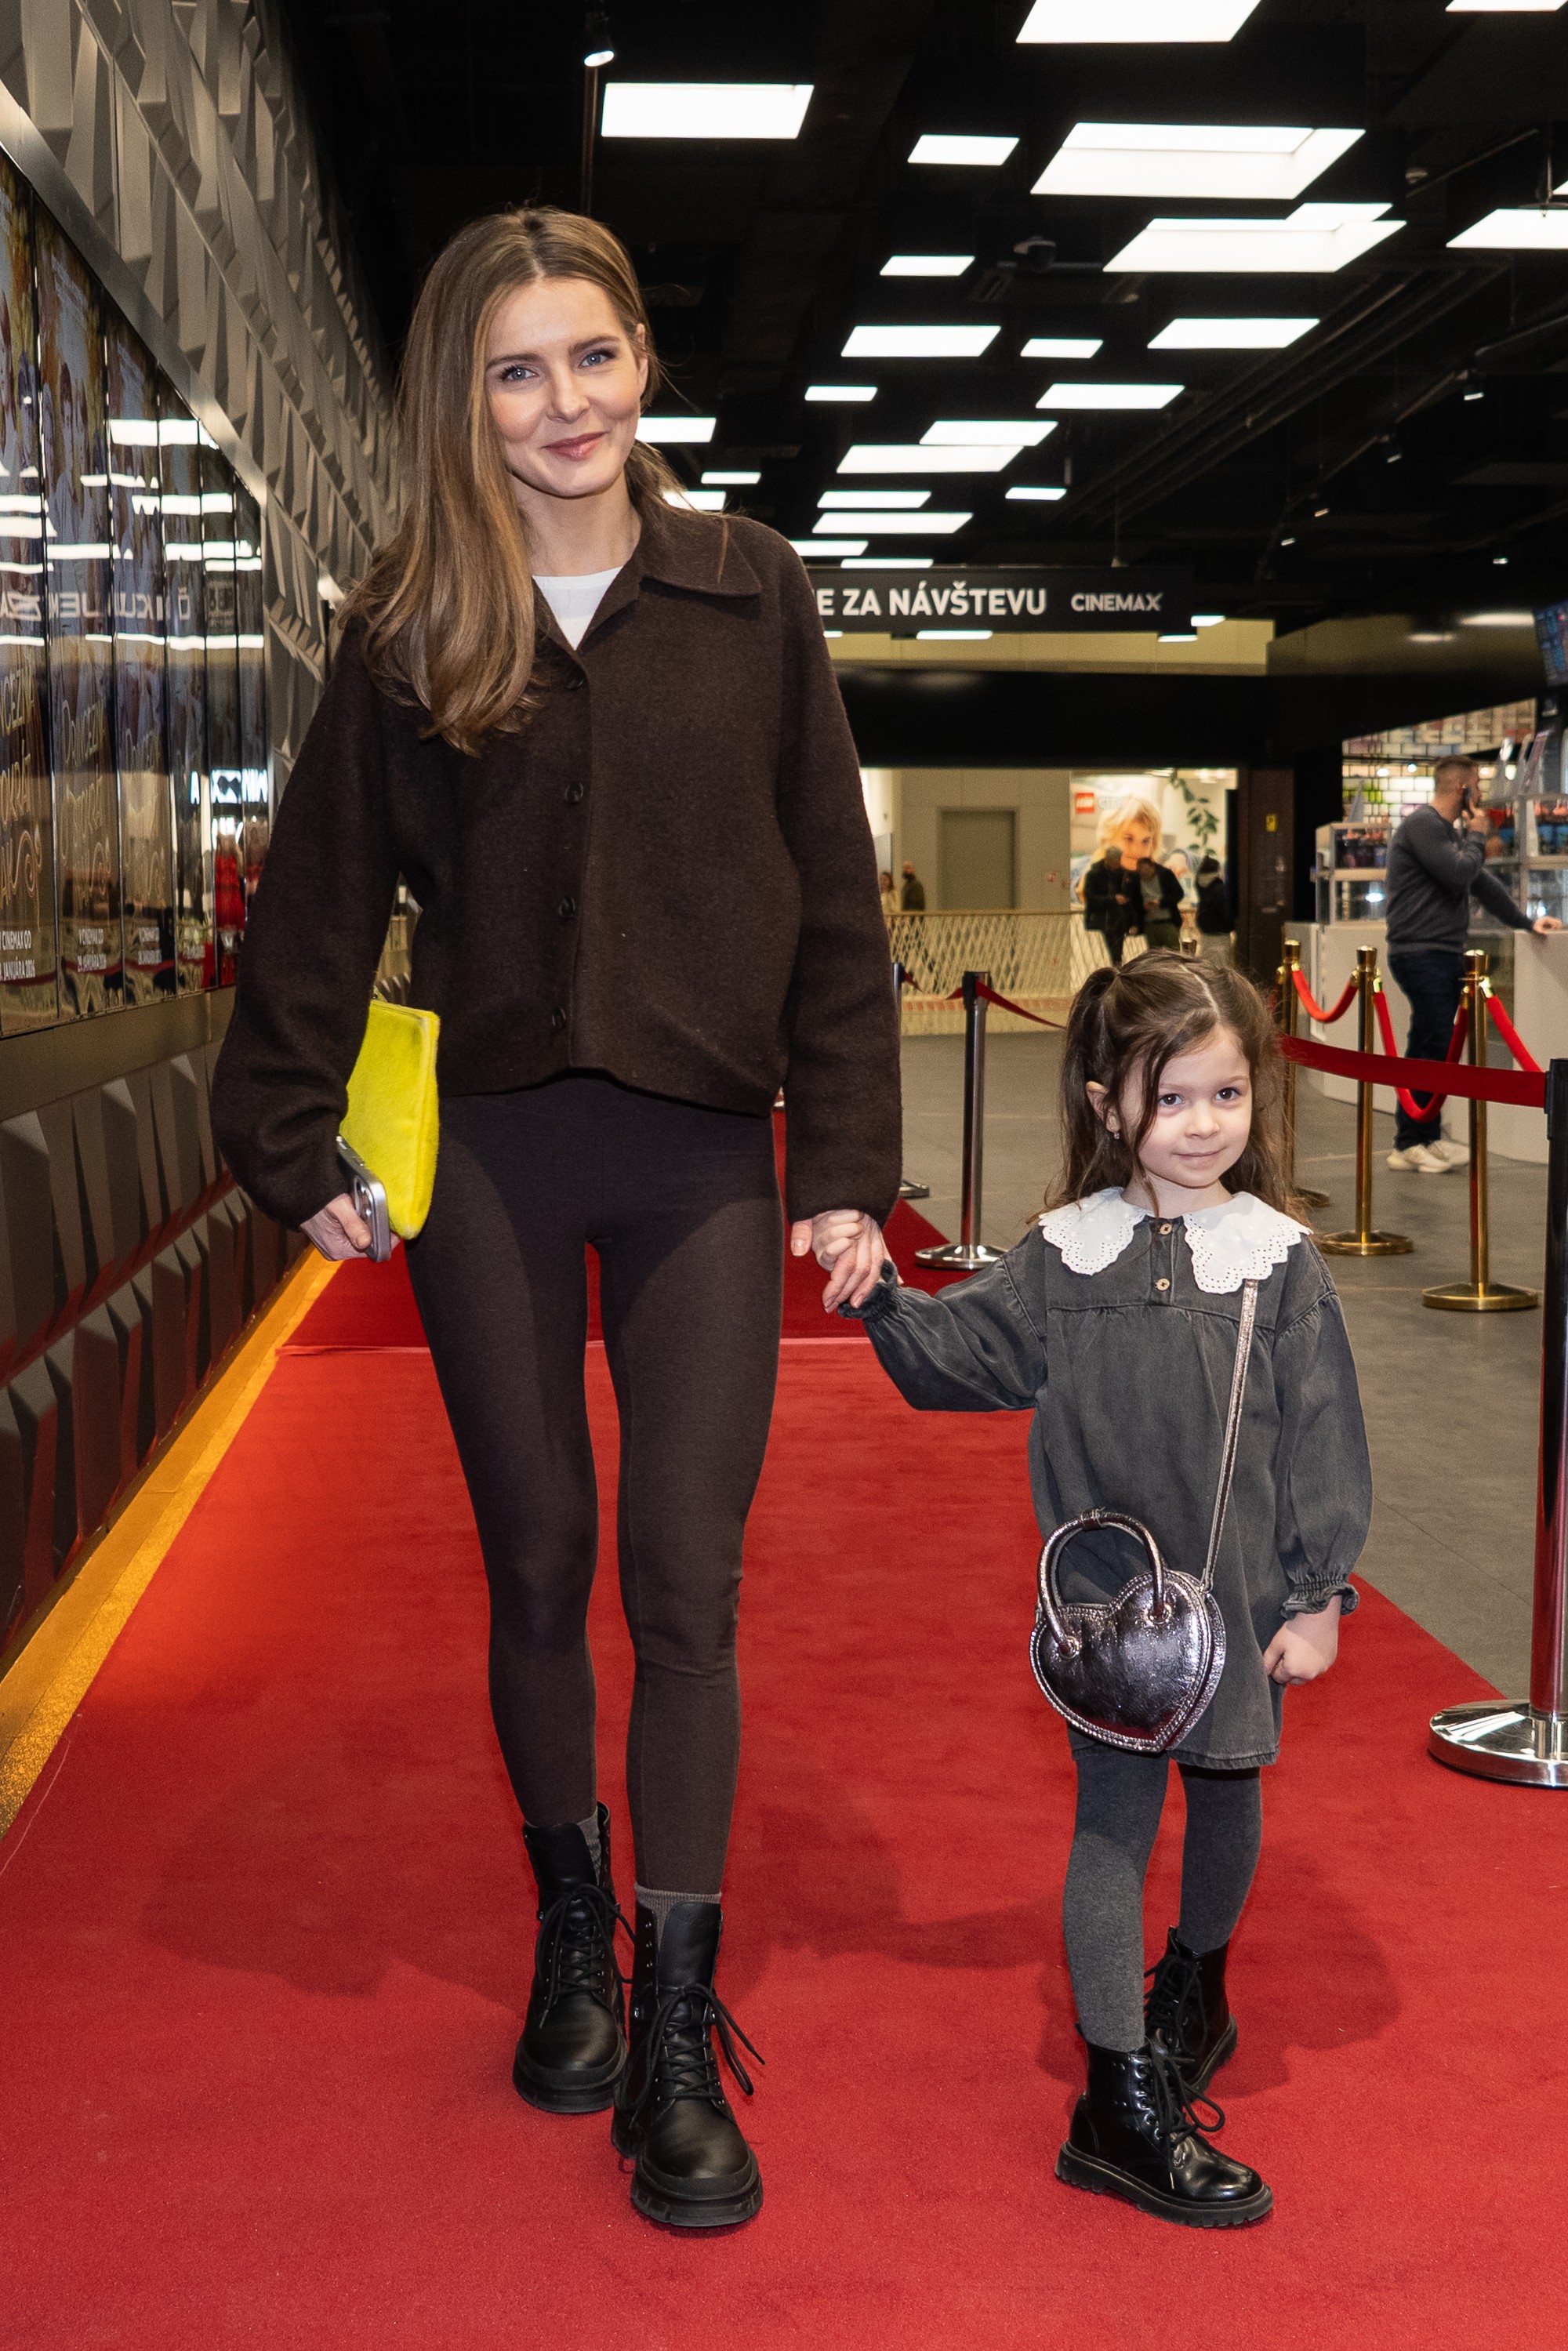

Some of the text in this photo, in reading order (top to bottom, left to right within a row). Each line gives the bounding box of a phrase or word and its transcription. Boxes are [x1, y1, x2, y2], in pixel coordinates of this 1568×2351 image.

[842, 588, 882, 616] ZA
[889, 580, 1046, 616] NÁVŠTEVU
[1070, 592, 1163, 612] CINEMAX
